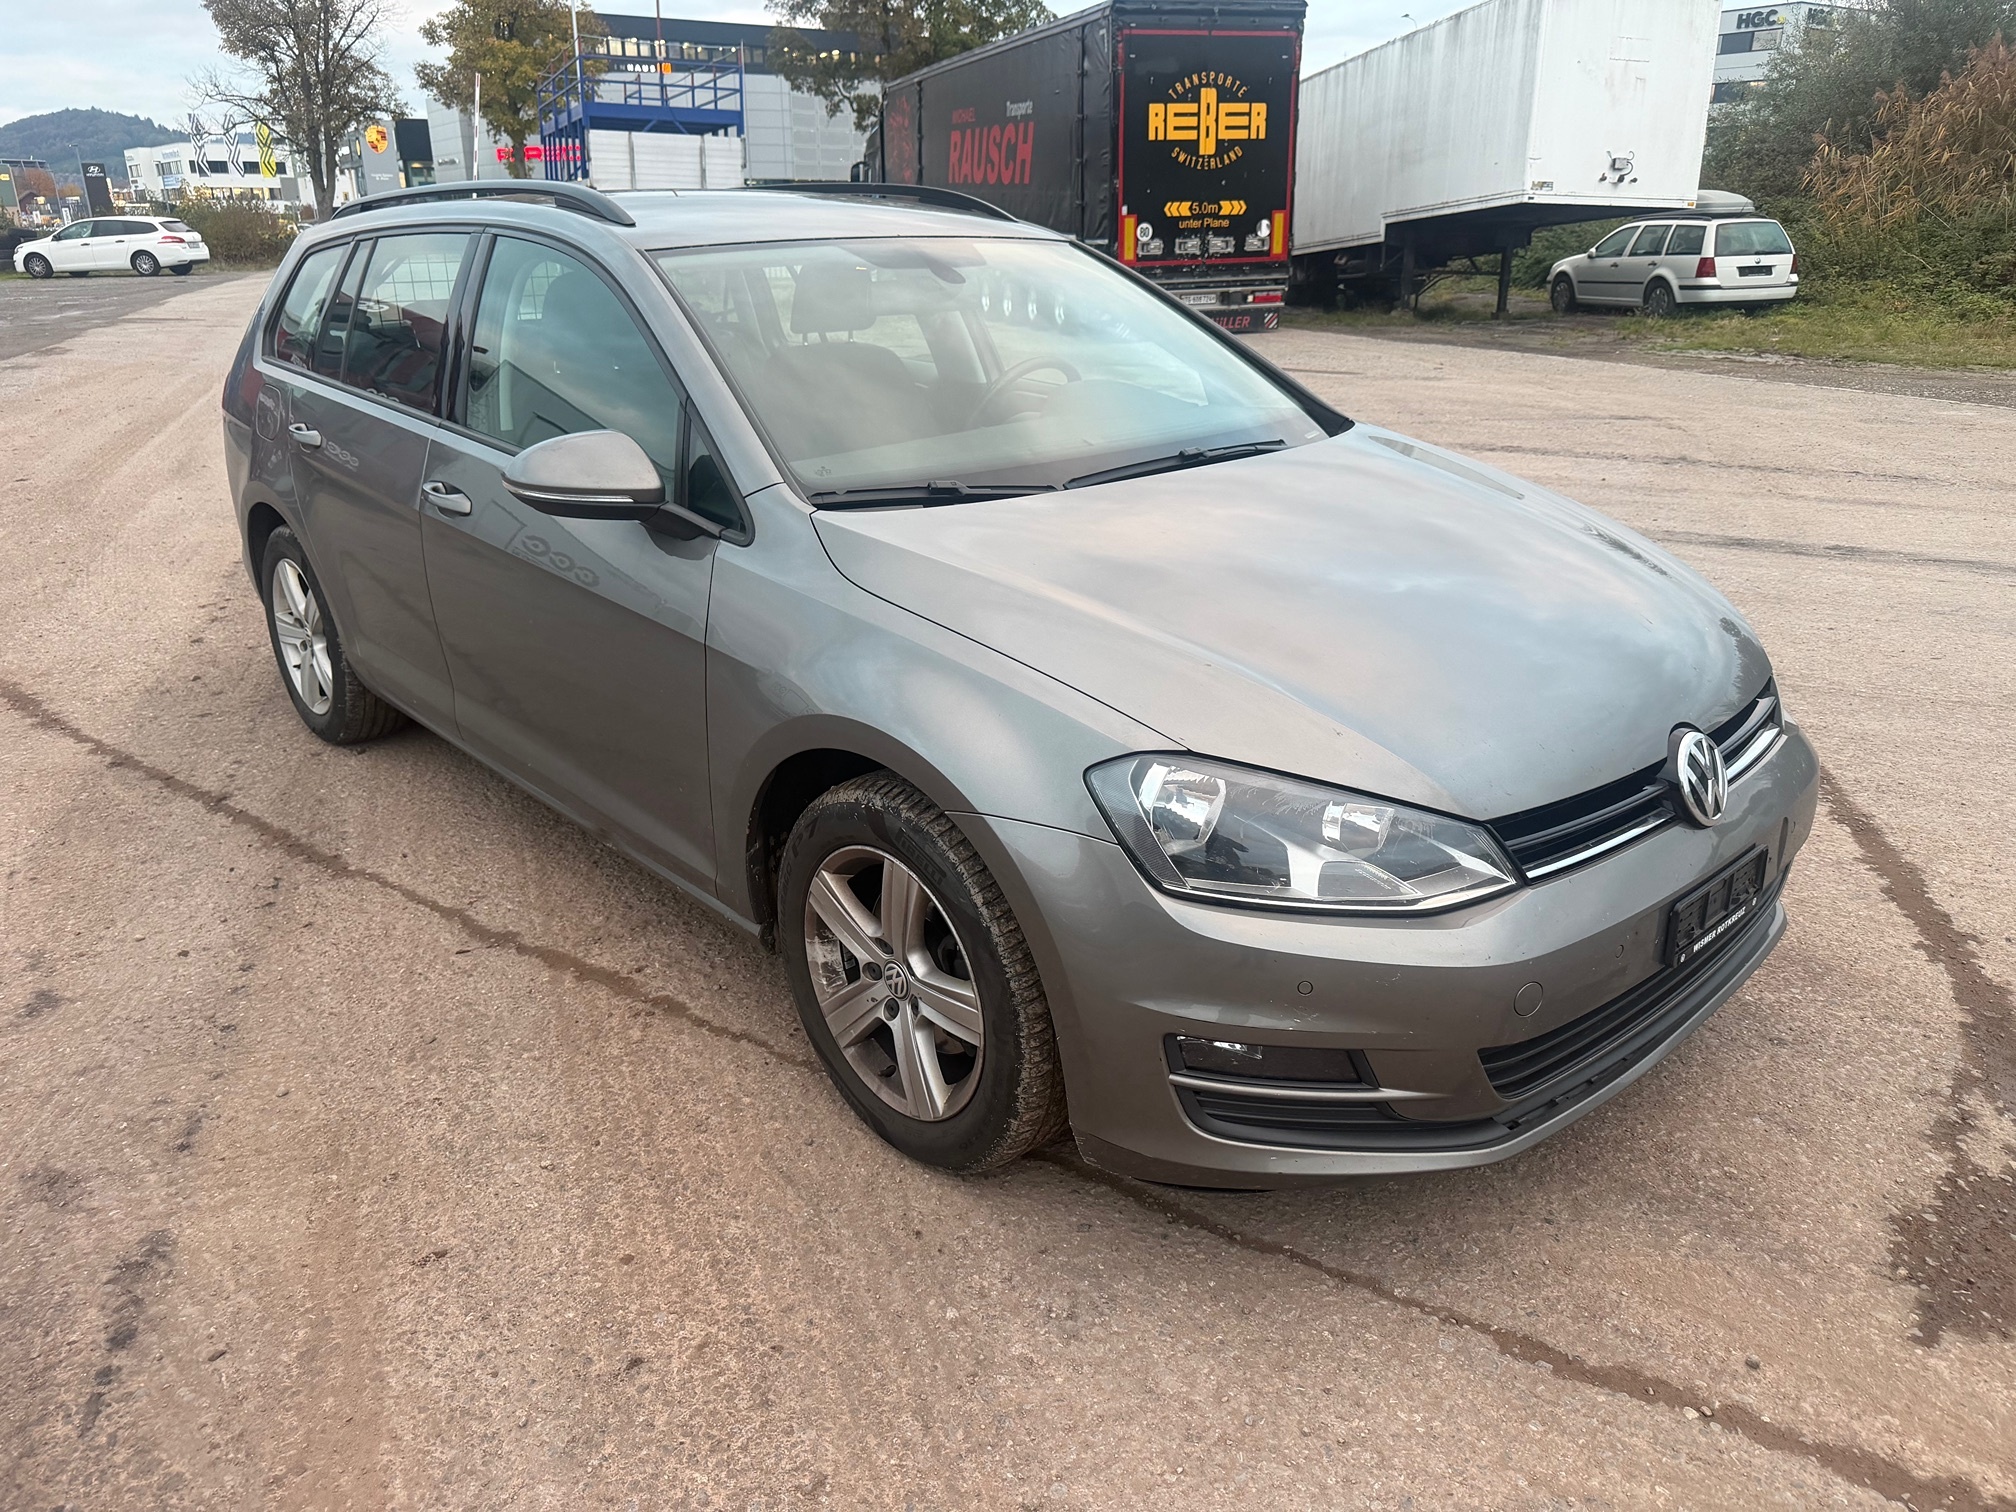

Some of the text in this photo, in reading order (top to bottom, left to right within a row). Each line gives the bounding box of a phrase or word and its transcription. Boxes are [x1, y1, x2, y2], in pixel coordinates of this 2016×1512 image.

[1736, 9, 1778, 29] HGC
[1168, 71, 1248, 99] TRANSPORTE
[1148, 88, 1267, 155] REBER
[948, 121, 1034, 185] RAUSCH
[1171, 146, 1243, 170] SWITZERLAND
[1192, 202, 1218, 214] 5.0m
[1139, 225, 1150, 238] 80
[1179, 217, 1230, 229] unter Plane
[1693, 906, 1746, 953] WISMER ROTKREUZ
